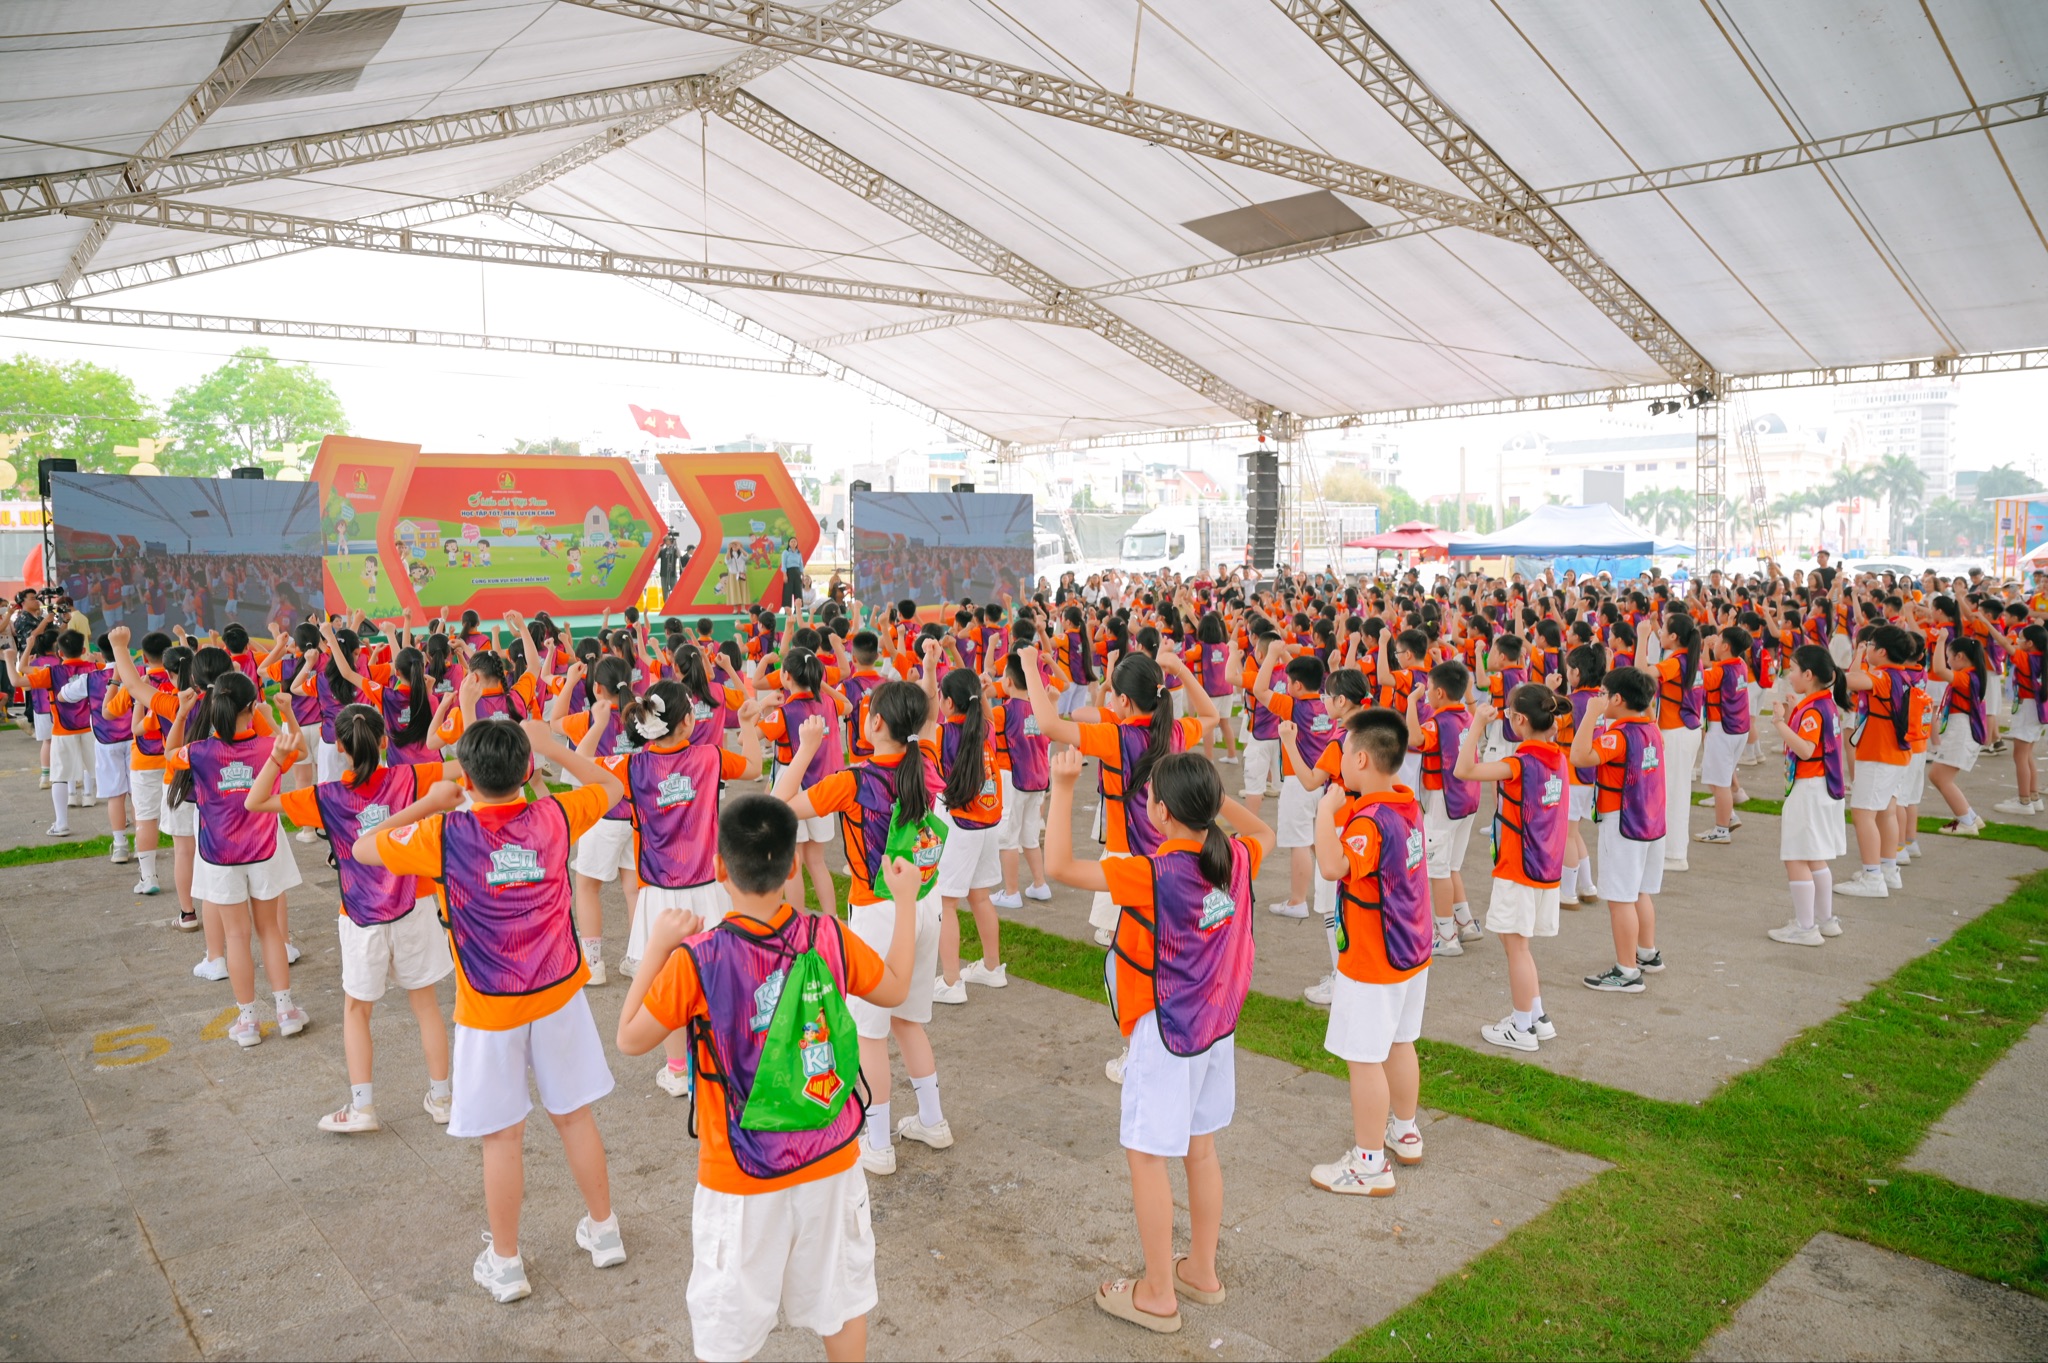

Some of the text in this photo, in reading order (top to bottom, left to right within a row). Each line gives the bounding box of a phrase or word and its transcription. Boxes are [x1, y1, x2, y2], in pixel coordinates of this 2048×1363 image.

[461, 510, 475, 518] HỌC
[223, 767, 251, 779] KUN
[660, 778, 690, 796] KUN
[358, 807, 389, 825] KUN
[493, 852, 535, 869] KUN
[487, 873, 507, 883] LÀM
[529, 867, 546, 879] TỐT
[93, 1024, 173, 1066] 5
